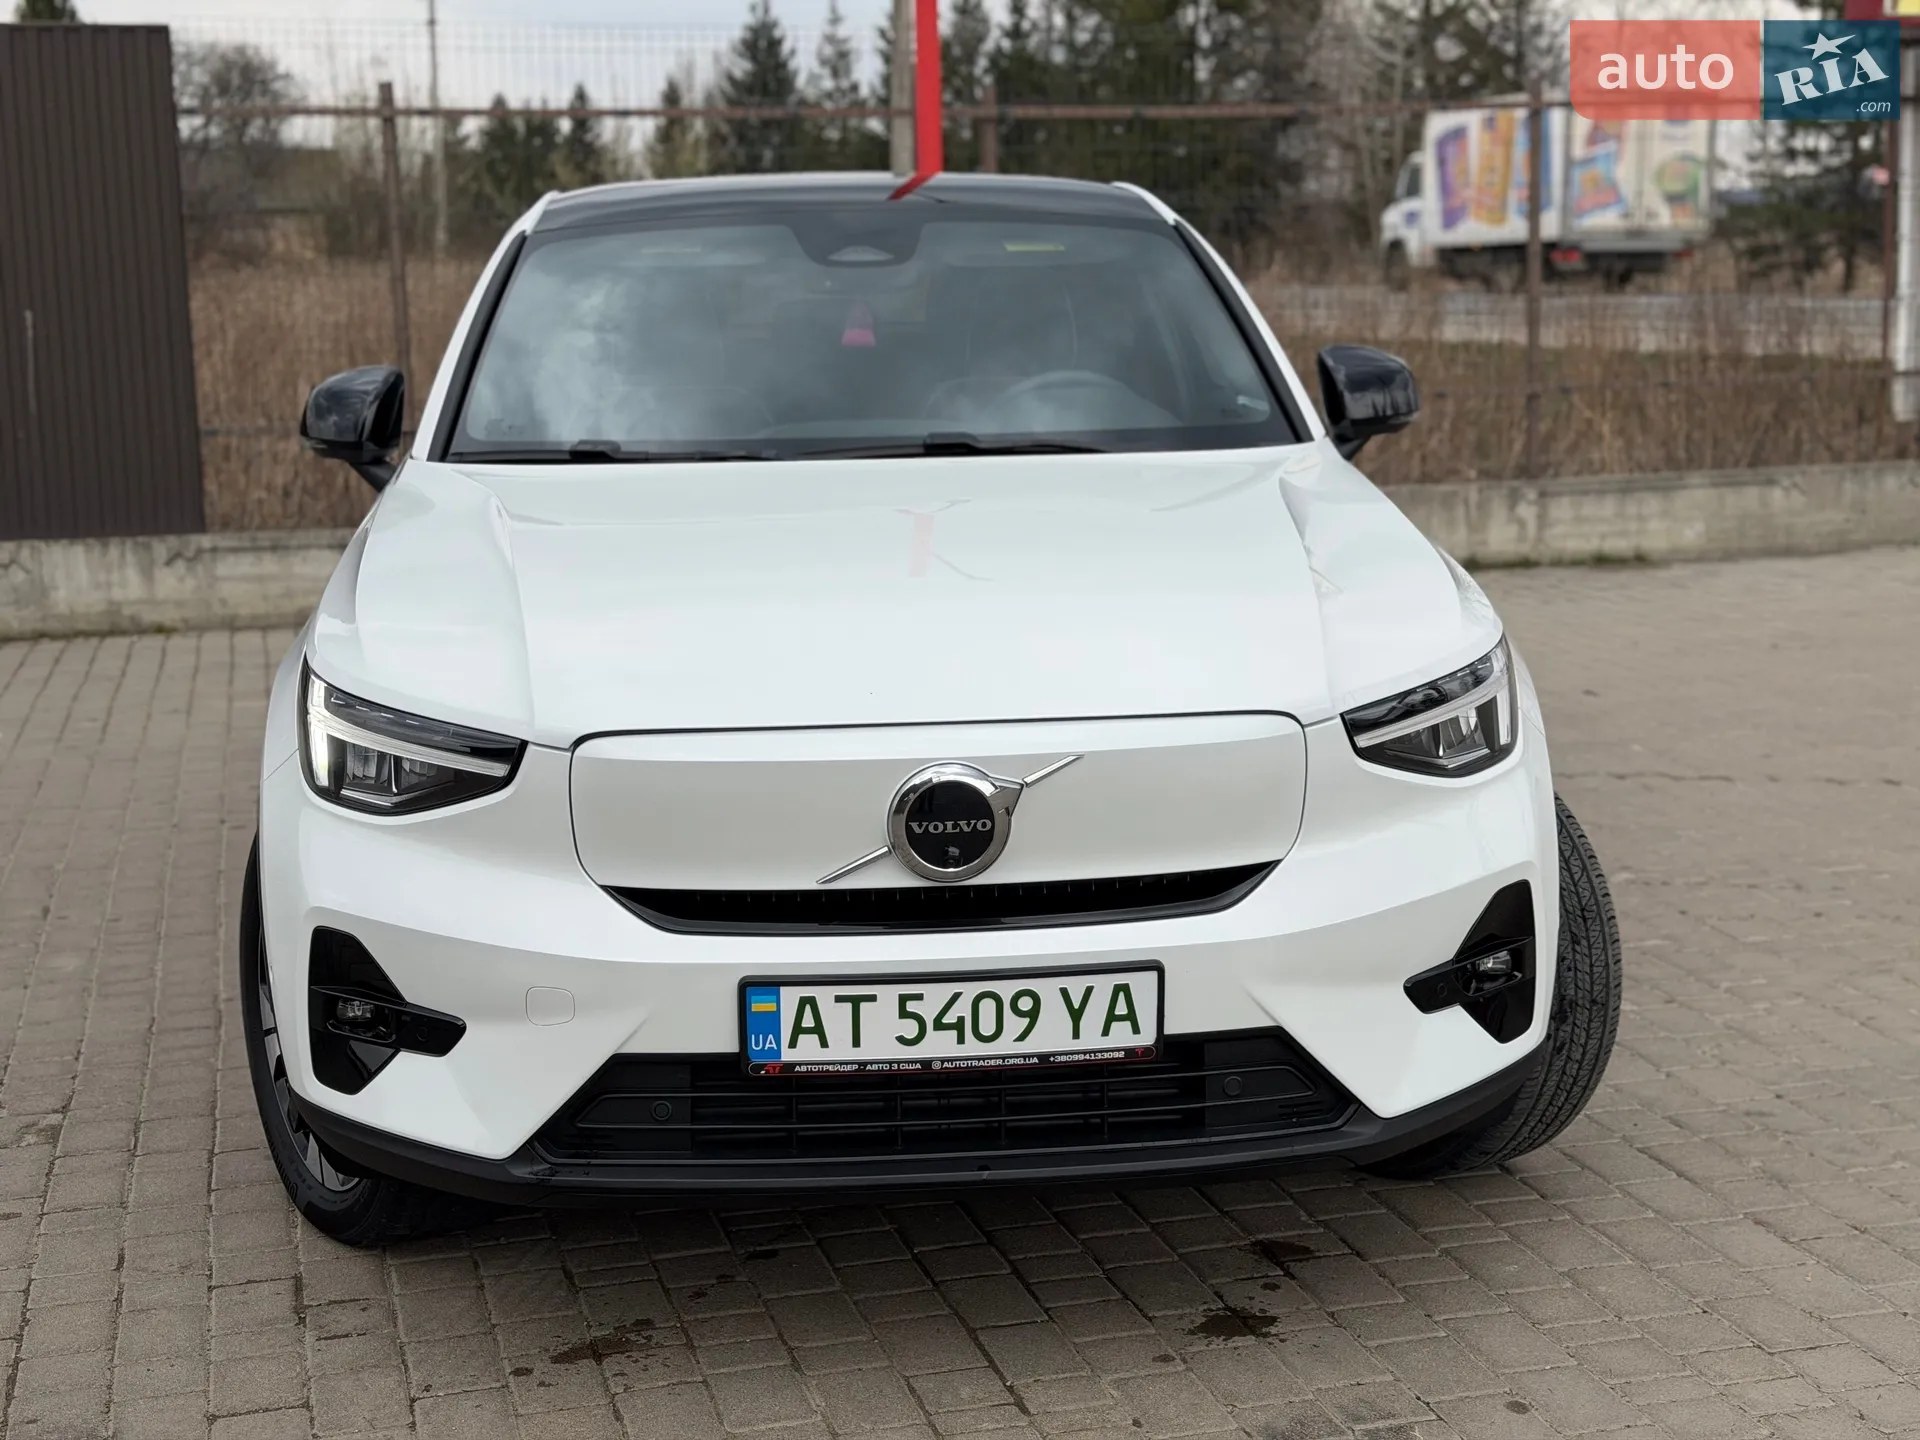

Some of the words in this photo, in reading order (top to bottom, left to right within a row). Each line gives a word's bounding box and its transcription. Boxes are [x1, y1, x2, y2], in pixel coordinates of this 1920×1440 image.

[908, 819, 992, 834] VOLVO
[787, 994, 878, 1049] AT
[894, 988, 1042, 1047] 5409
[1058, 982, 1142, 1040] YA
[751, 1033, 778, 1051] UA
[942, 1056, 1039, 1068] AUTOTRADER.ORG.UA
[1049, 1051, 1125, 1062] +380994133092
[794, 1063, 859, 1072] АВТОТРЕЙДЕР
[866, 1063, 890, 1071] АВТО
[899, 1062, 922, 1070] США
